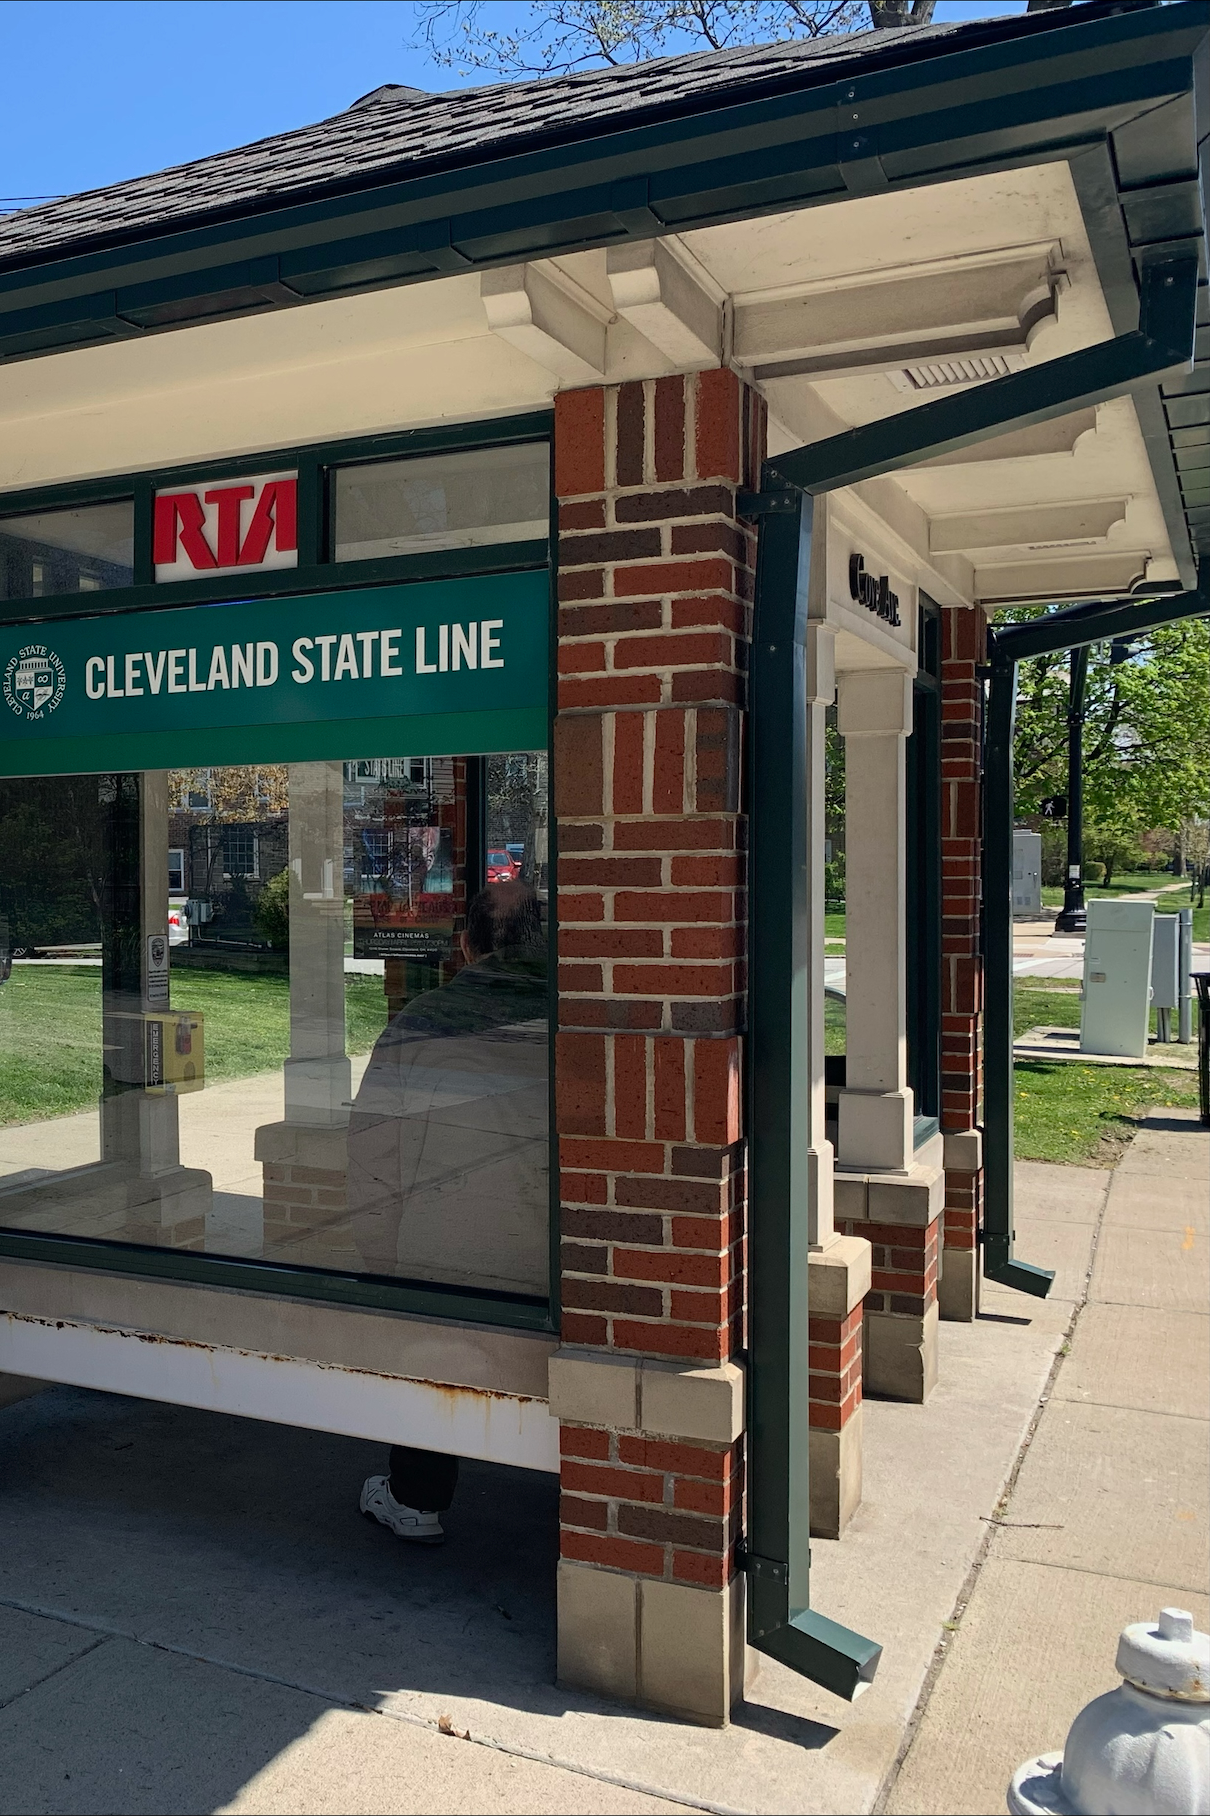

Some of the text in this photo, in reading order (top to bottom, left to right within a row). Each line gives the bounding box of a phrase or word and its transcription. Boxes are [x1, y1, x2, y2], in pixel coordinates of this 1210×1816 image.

[153, 479, 297, 569] RTA
[3, 645, 66, 715] CLEVELAND STATE UNIVERSITY
[85, 619, 504, 699] CLEVELAND STATE LINE
[26, 710, 44, 720] 1964
